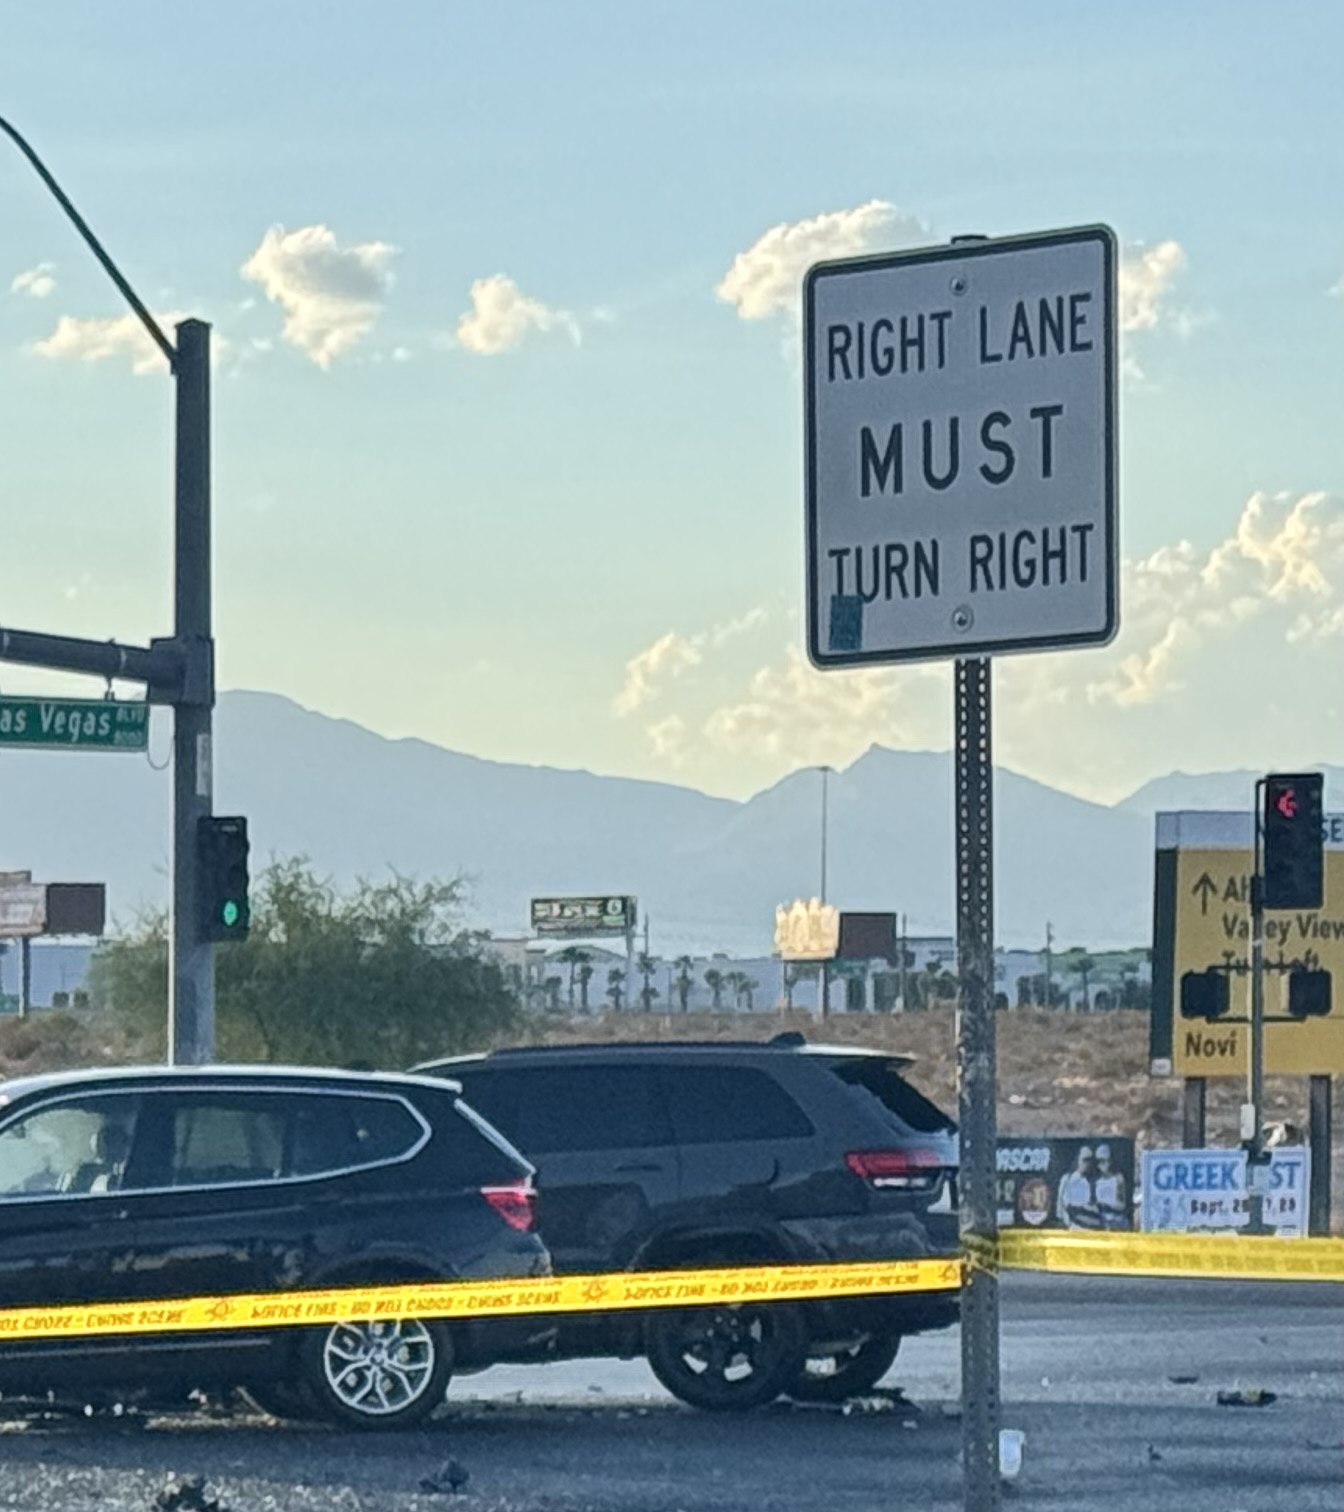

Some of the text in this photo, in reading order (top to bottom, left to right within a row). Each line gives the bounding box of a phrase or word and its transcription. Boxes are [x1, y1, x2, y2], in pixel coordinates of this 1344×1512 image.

[827, 292, 1093, 383] RIGHT LANE
[860, 404, 1064, 498] MUST
[828, 523, 1094, 604] TURN RIGHT
[40, 704, 111, 743] Vegas
[1222, 913, 1292, 946] Vaey
[1185, 1031, 1237, 1058] Novi
[1153, 1161, 1240, 1191] GREEK
